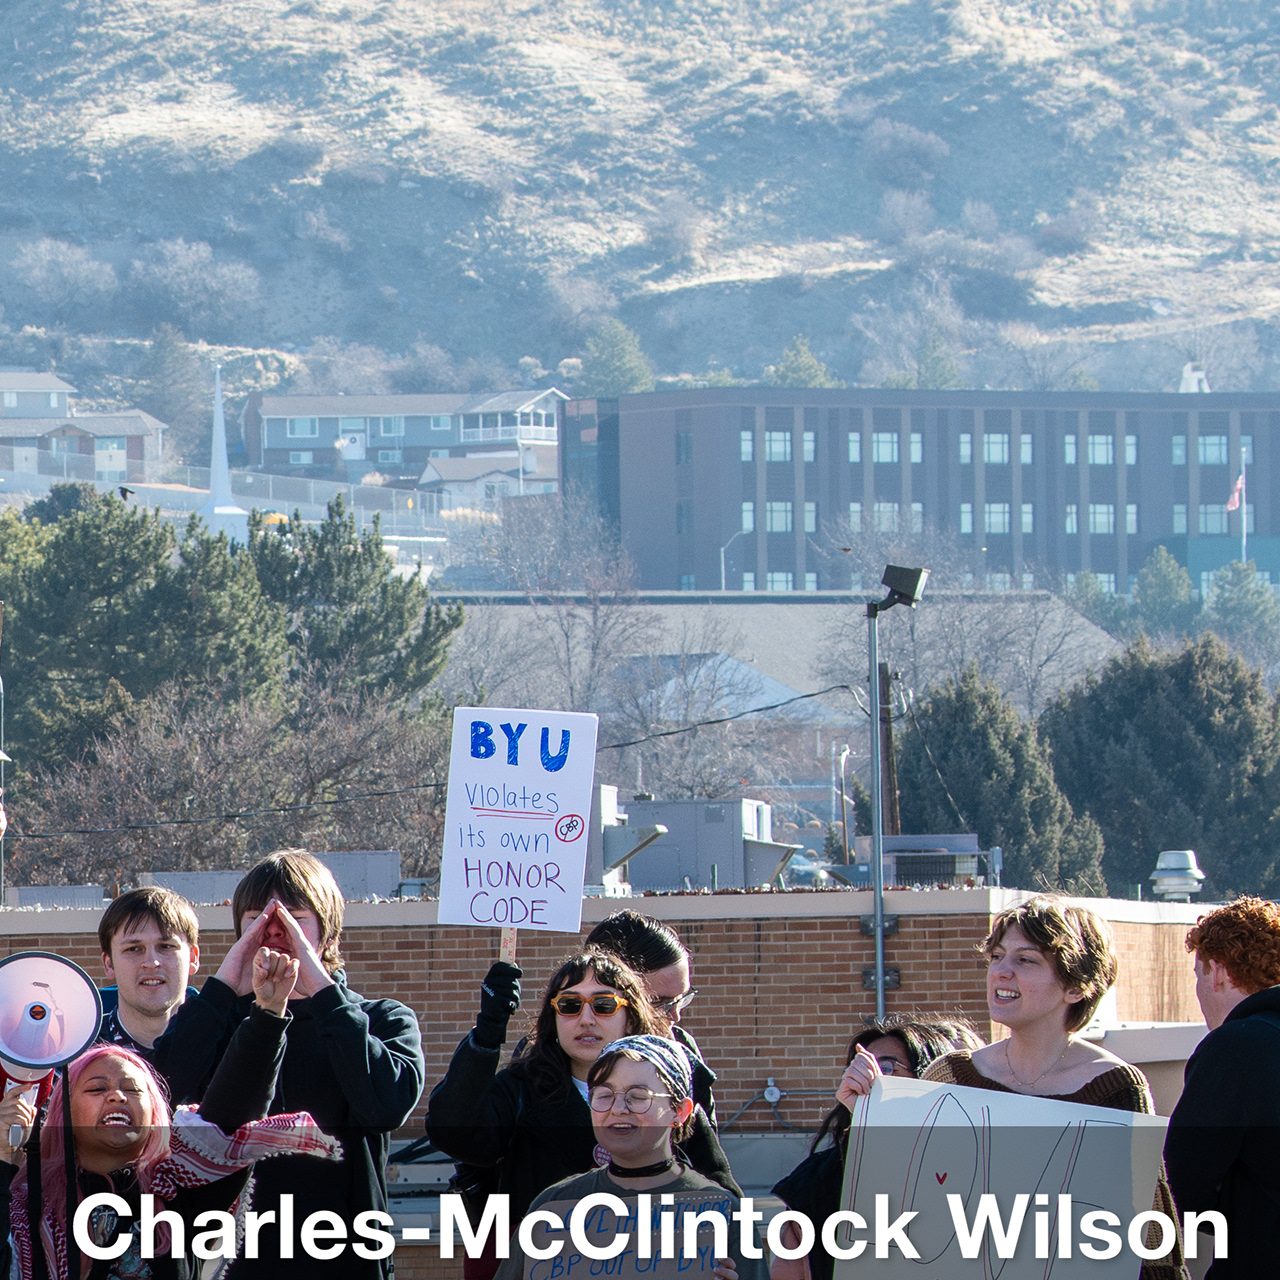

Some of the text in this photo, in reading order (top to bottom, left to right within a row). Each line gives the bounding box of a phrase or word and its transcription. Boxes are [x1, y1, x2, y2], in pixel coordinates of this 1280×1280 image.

[471, 721, 571, 773] BYU
[459, 823, 550, 854] its own
[559, 819, 579, 837] CBP
[464, 858, 566, 893] HONOR
[470, 891, 548, 925] CODE
[589, 1250, 634, 1276] OUT
